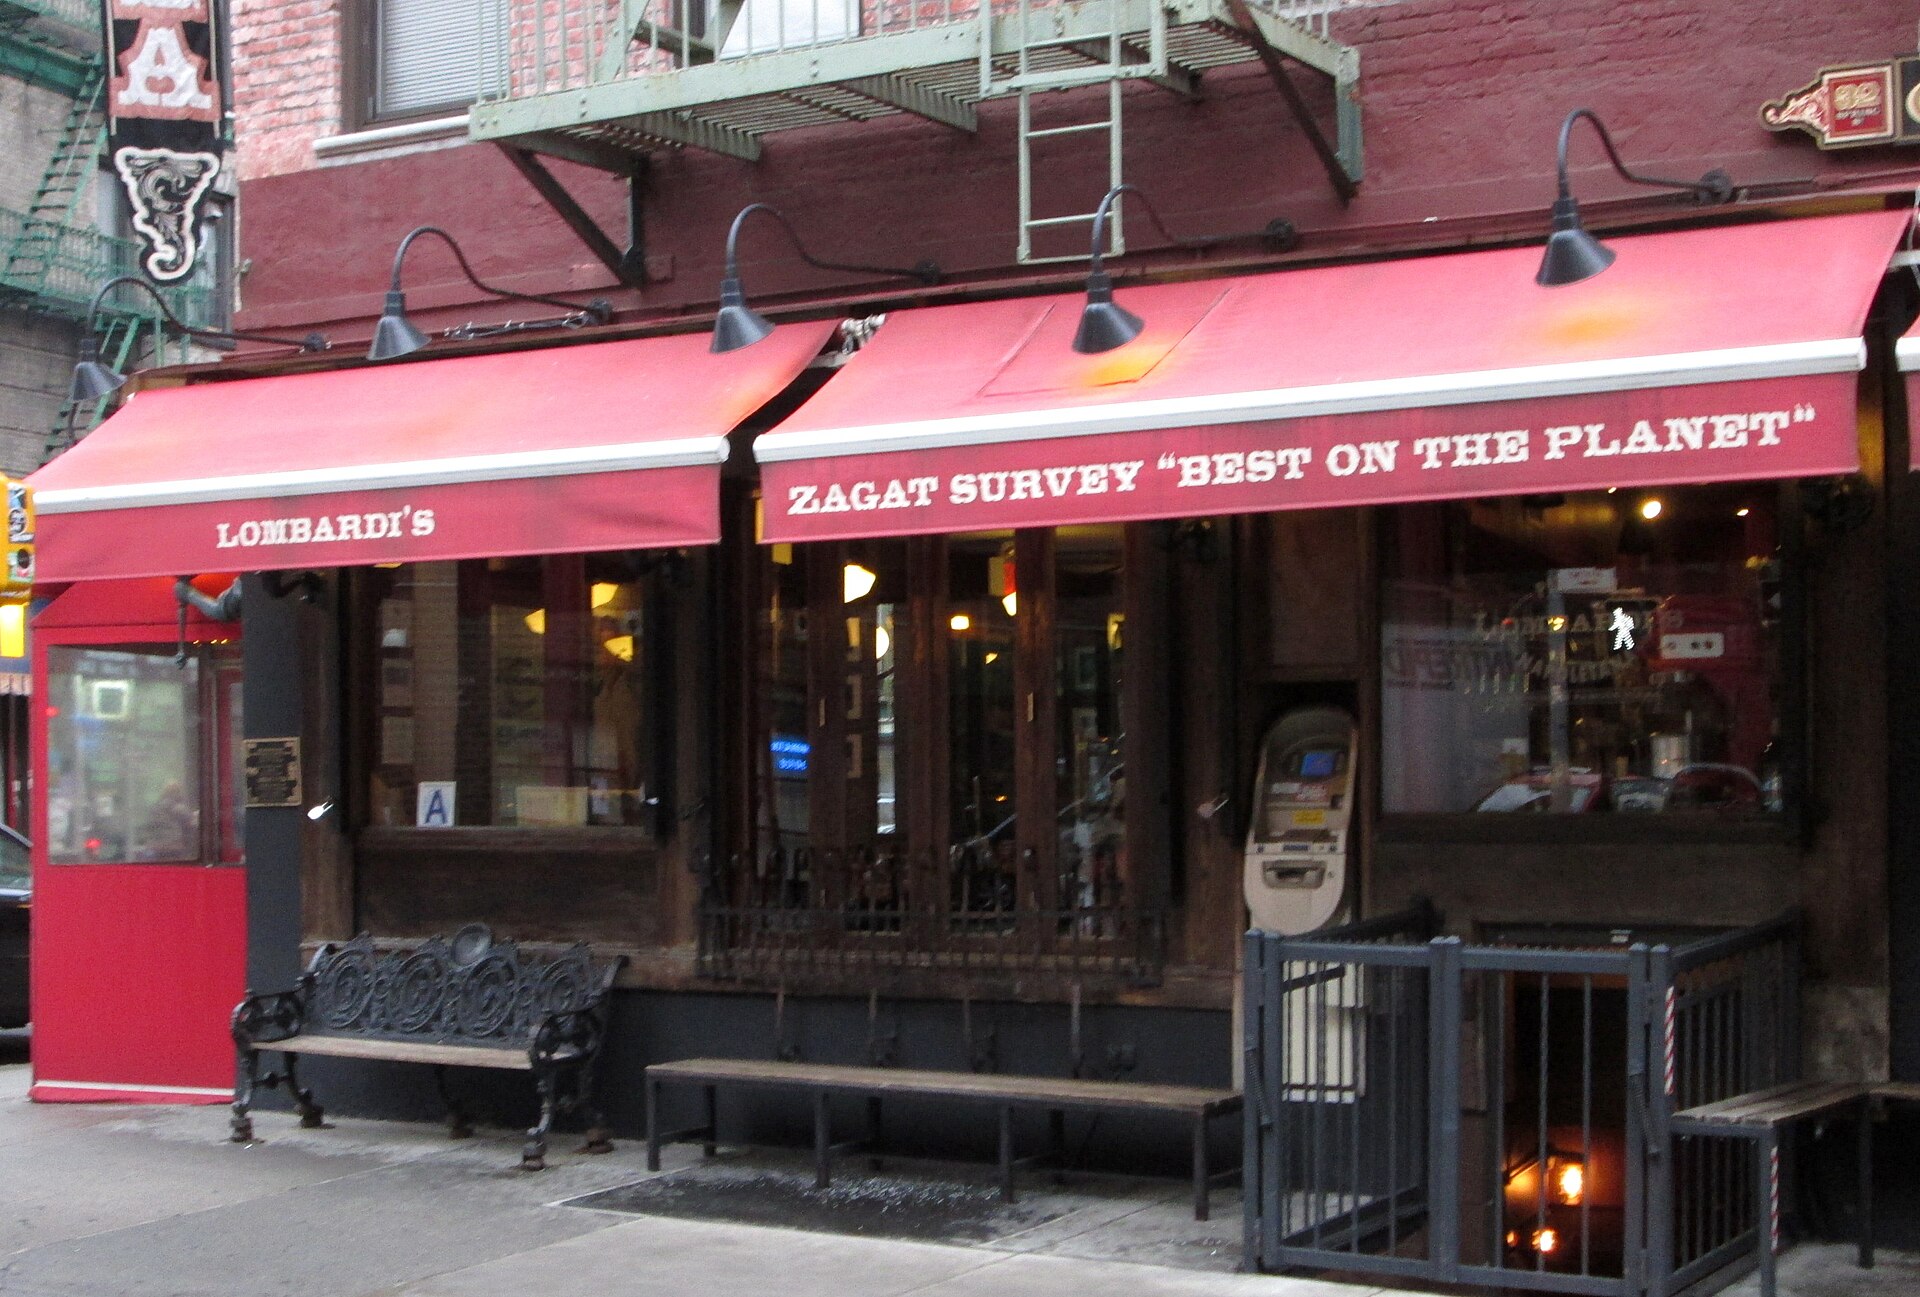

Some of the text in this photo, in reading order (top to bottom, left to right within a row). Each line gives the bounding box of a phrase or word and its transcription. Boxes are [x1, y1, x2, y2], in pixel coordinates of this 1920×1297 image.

[787, 475, 939, 515] ZAGAT
[949, 460, 1144, 505] SURVEY
[1325, 440, 1400, 477] ON
[1413, 430, 1529, 469] THE
[216, 504, 436, 549] LOMBARDI'S
[425, 789, 447, 824] A
